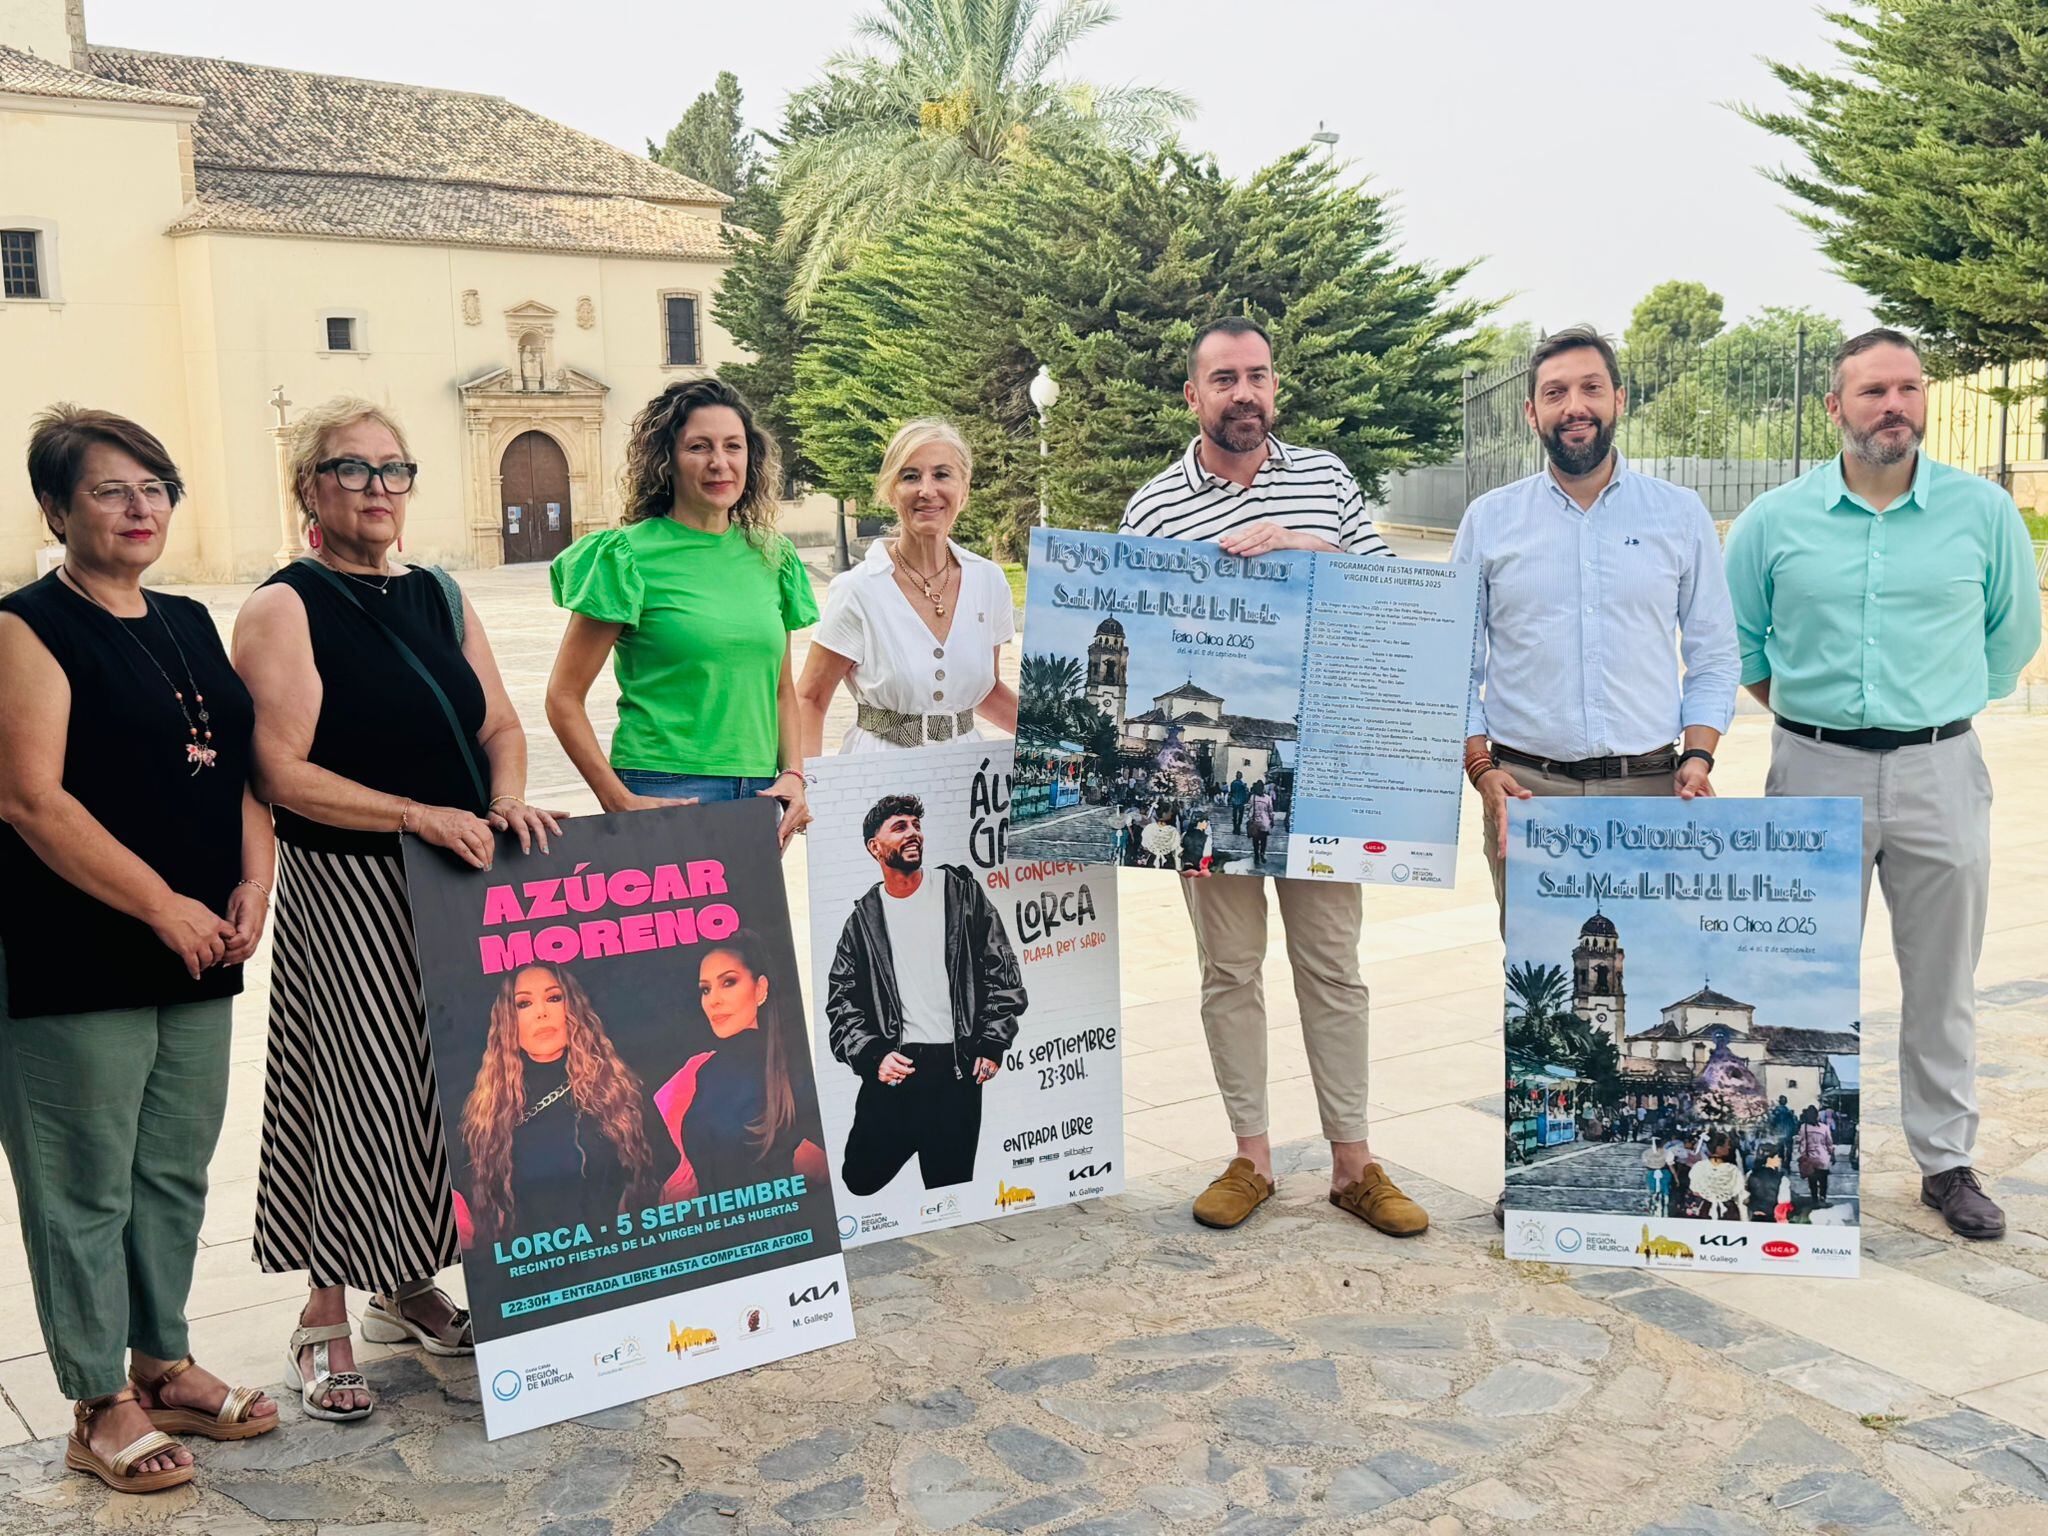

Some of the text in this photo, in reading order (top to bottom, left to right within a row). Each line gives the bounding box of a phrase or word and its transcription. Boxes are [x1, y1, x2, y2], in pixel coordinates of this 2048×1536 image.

[1329, 560, 1457, 579] PROGRAMACIÓN FIESTAS PATRONALES
[1343, 573, 1441, 588] VIRGEN DE LAS HUERTAS 2025
[1172, 629, 1255, 650] Feria Chica 2025
[483, 859, 729, 926] AZÚCAR
[1016, 884, 1096, 945] LORCA
[1700, 914, 1817, 935] Feria Chica 2025
[479, 903, 740, 975] MORENO
[1023, 944, 1053, 965] PLAZA
[1080, 932, 1106, 952] SABIO
[1006, 1050, 1024, 1072] 06
[1069, 1185, 1104, 1198] M. Gallego
[494, 1223, 593, 1265] LORCA
[617, 1213, 633, 1236] 5
[641, 1174, 807, 1230] SEPTIEMBRE
[509, 1201, 800, 1278] RECINTO FIESTAS DE LA VIRGEN DE LAS HUERTAS
[1764, 1245, 1796, 1254] LUCAS
[1700, 1254, 1738, 1263] M. Gallego
[508, 1294, 551, 1314] 22:30H
[562, 1278, 620, 1301] ENTRADA
[622, 1268, 658, 1286] LIBRE
[660, 1259, 699, 1277] HASTA
[701, 1241, 769, 1266] COMPLETAR
[772, 1232, 809, 1250] AFORO
[792, 1310, 834, 1328] M. Gallego
[527, 1371, 574, 1391] DE MURCIA
